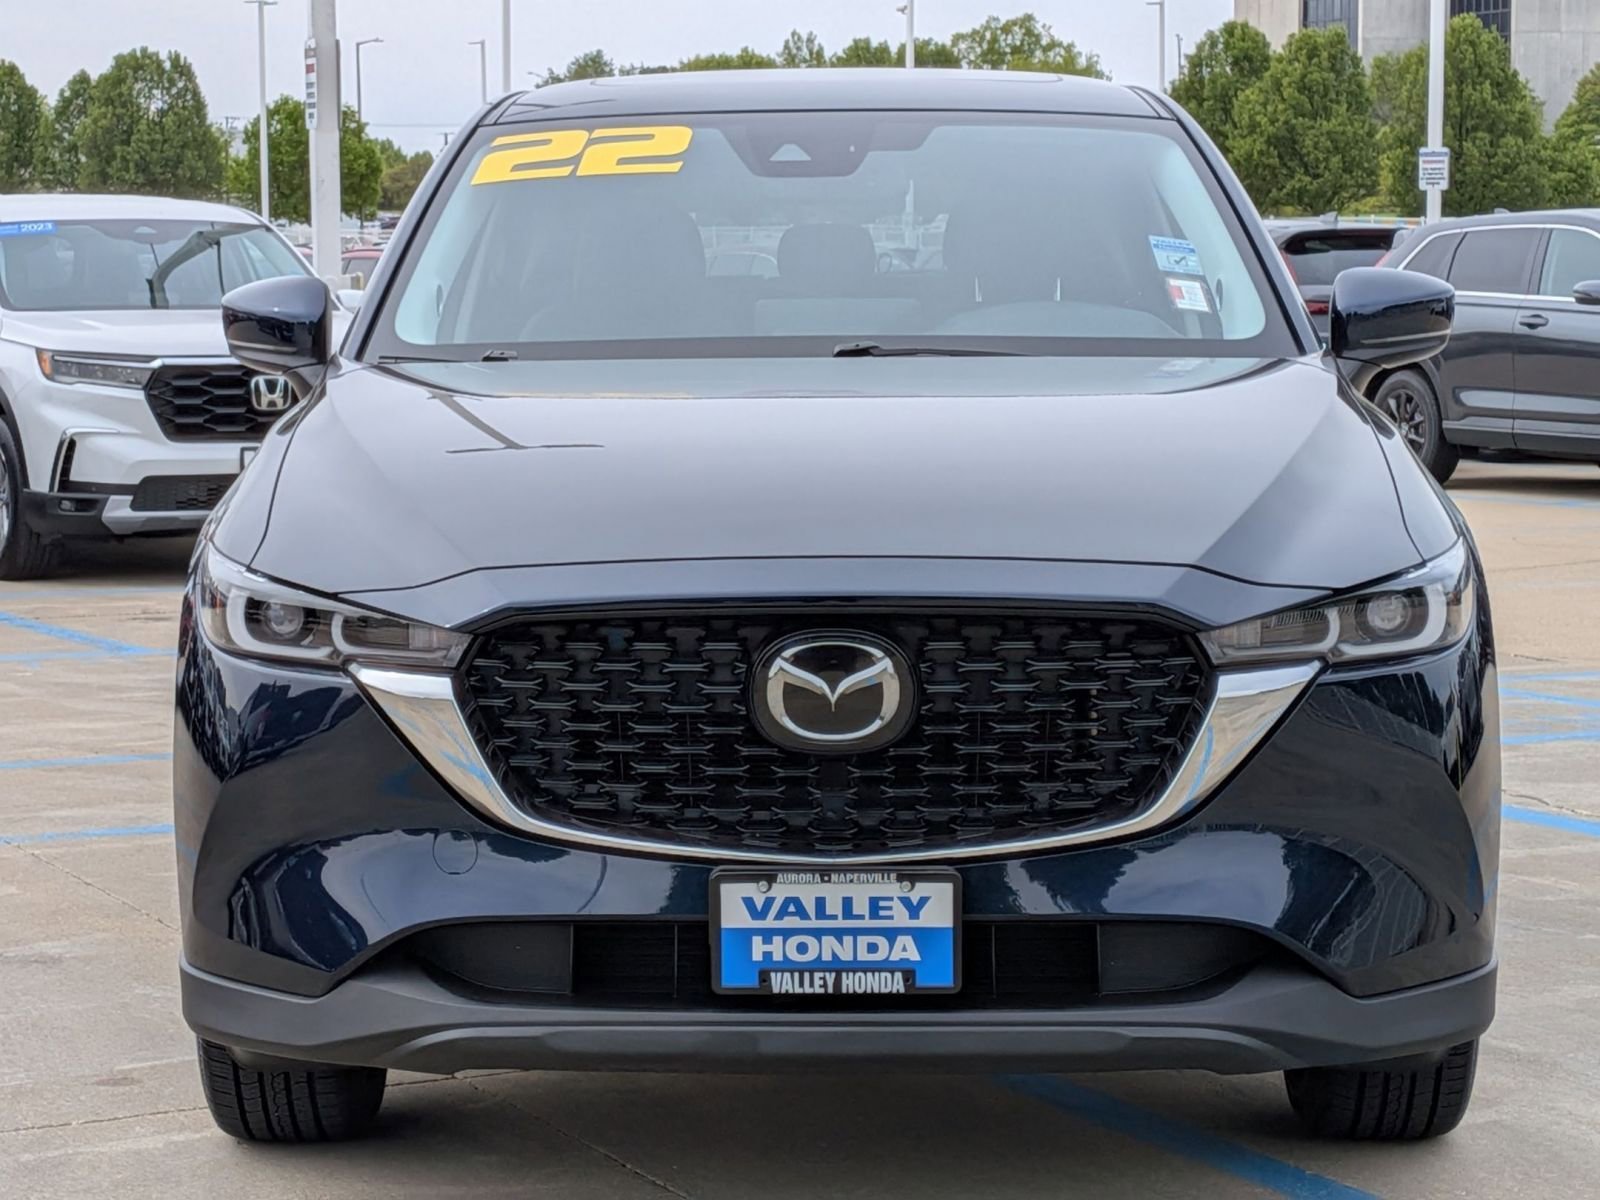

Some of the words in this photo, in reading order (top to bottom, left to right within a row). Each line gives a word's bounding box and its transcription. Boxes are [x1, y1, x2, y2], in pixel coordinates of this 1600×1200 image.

[470, 125, 693, 186] 22
[776, 873, 821, 884] AURORA
[831, 873, 897, 884] NAPERVILLE
[741, 896, 931, 921] VALLEY
[752, 935, 921, 961] HONDA
[770, 971, 836, 994] VALLEY
[841, 971, 905, 994] HONDA
